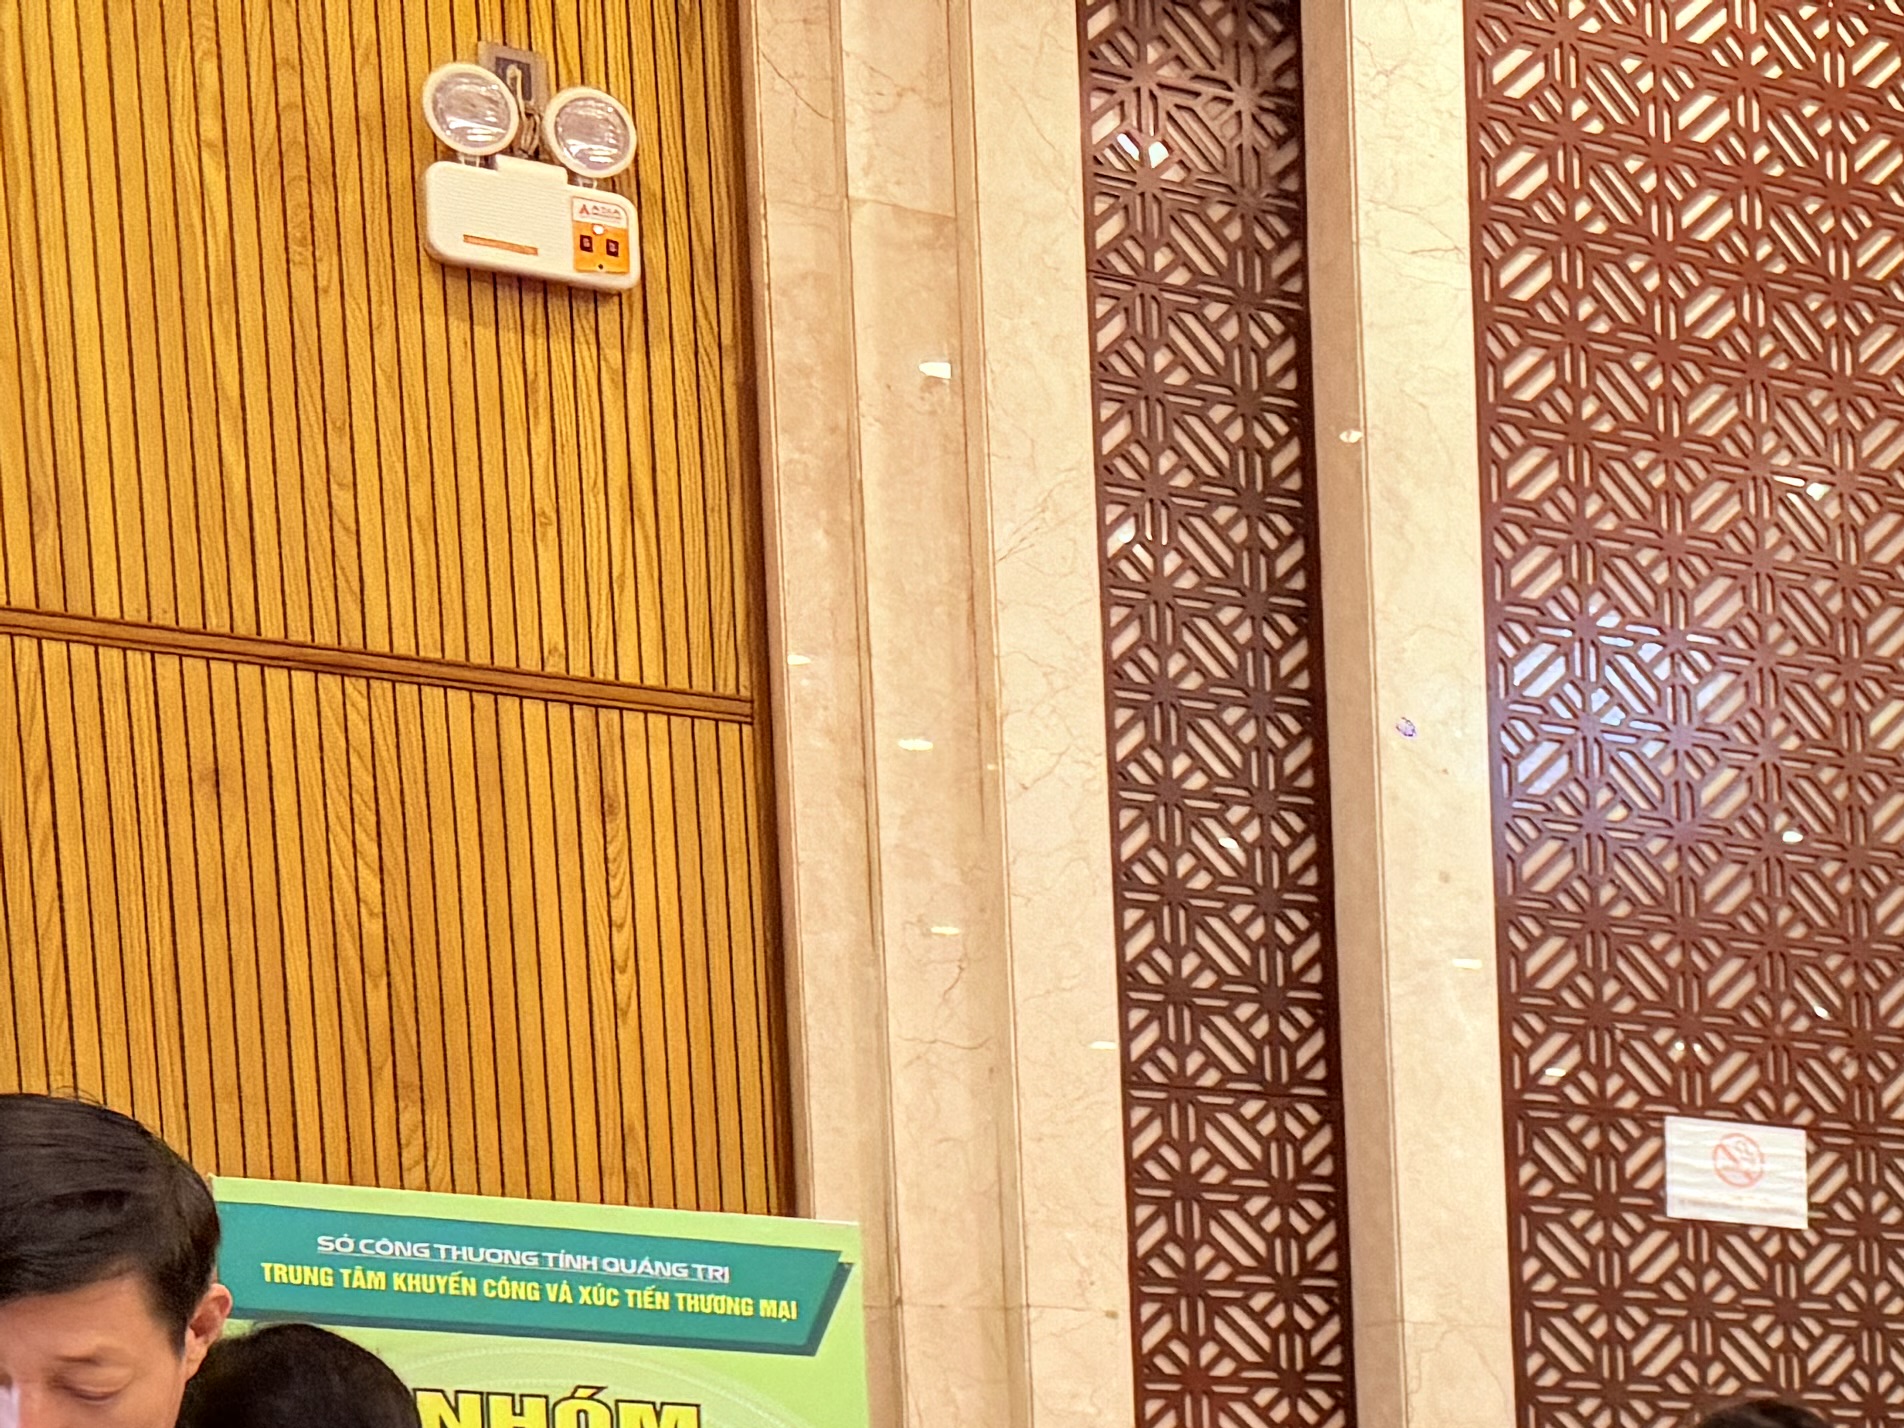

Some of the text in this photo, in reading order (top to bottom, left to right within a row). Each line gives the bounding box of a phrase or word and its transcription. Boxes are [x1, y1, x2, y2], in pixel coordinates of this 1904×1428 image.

[359, 1238, 430, 1258] CÔNG
[261, 1262, 334, 1287] TRUNG
[339, 1266, 386, 1290] TÂM
[393, 1270, 476, 1296] KHUYẾN
[483, 1276, 540, 1301] CÔNG
[579, 1282, 619, 1307] XÚC
[625, 1285, 669, 1310] TIẾN
[759, 1300, 798, 1323] MẠI
